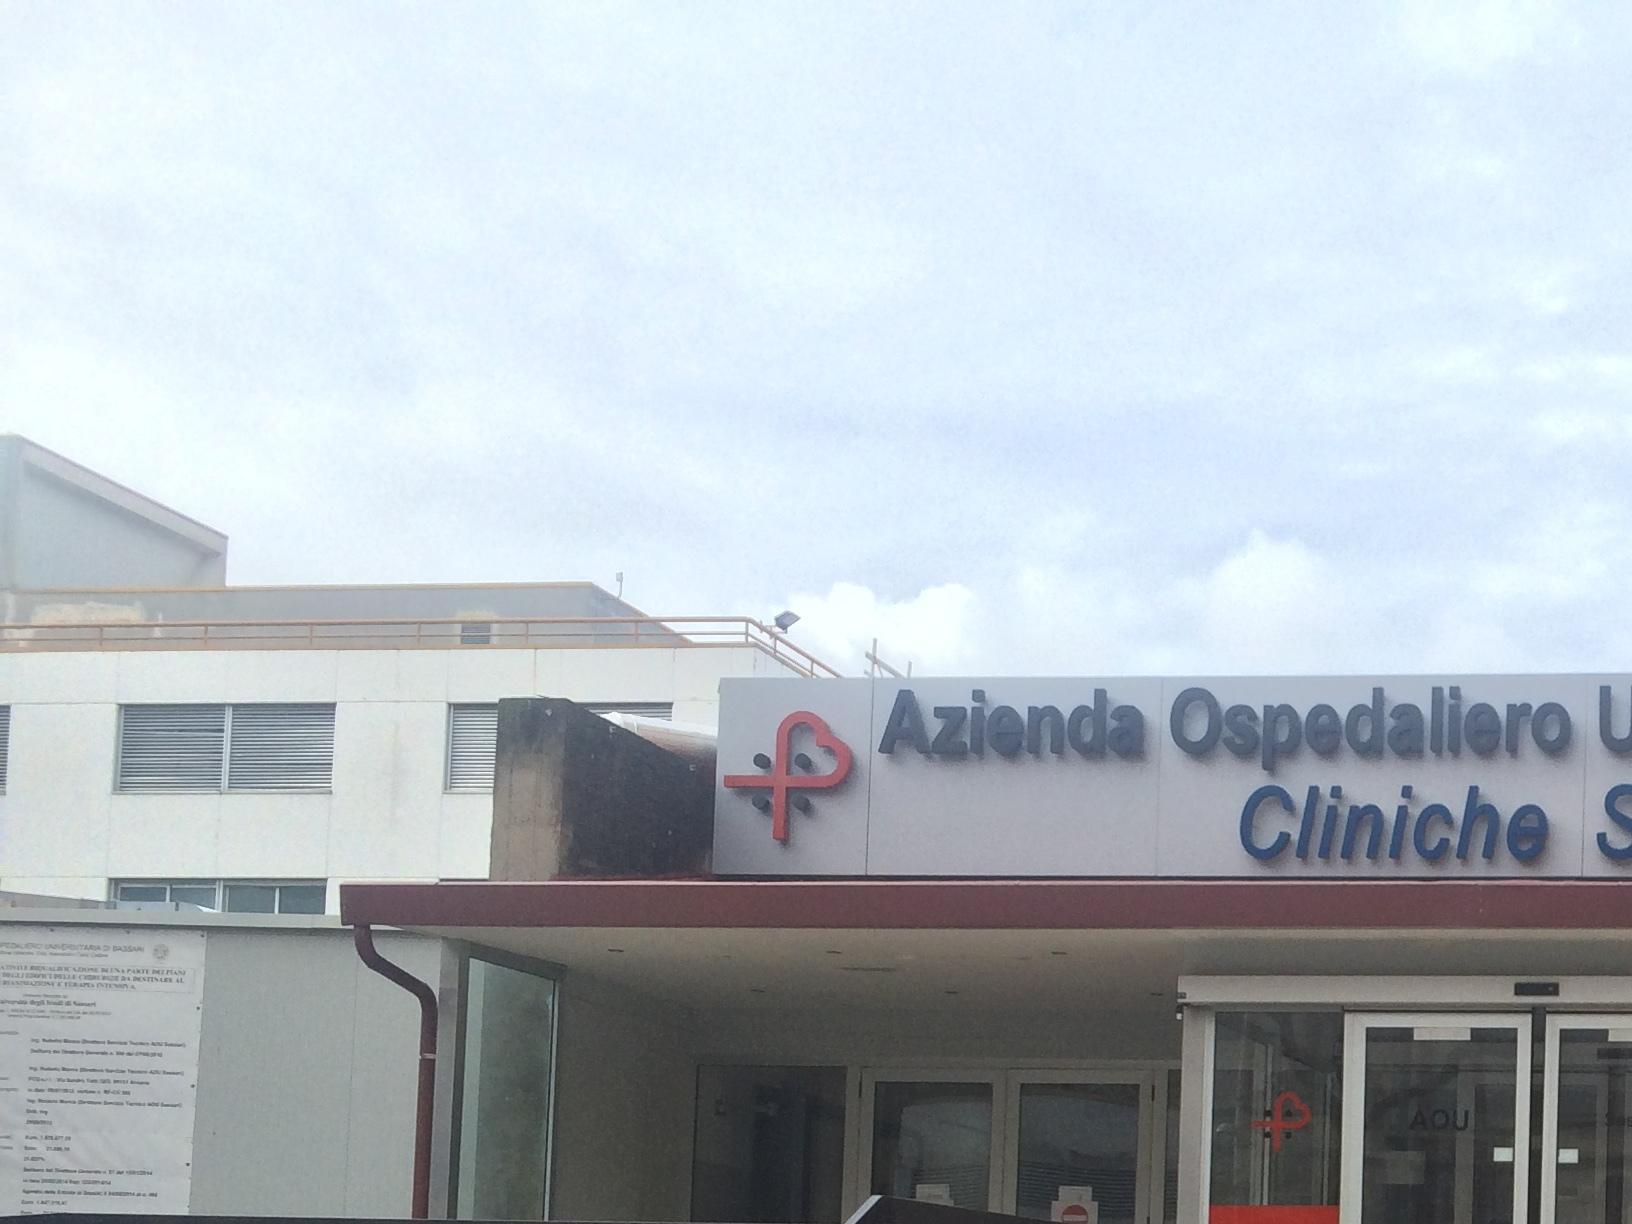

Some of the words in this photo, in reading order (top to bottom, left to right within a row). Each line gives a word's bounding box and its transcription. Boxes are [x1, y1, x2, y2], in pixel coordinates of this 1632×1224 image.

[878, 688, 1144, 756] Azienda
[1170, 685, 1572, 770] Ospedaliero
[1239, 784, 1551, 862] Cliniche
[1409, 1108, 1469, 1131] AOU
